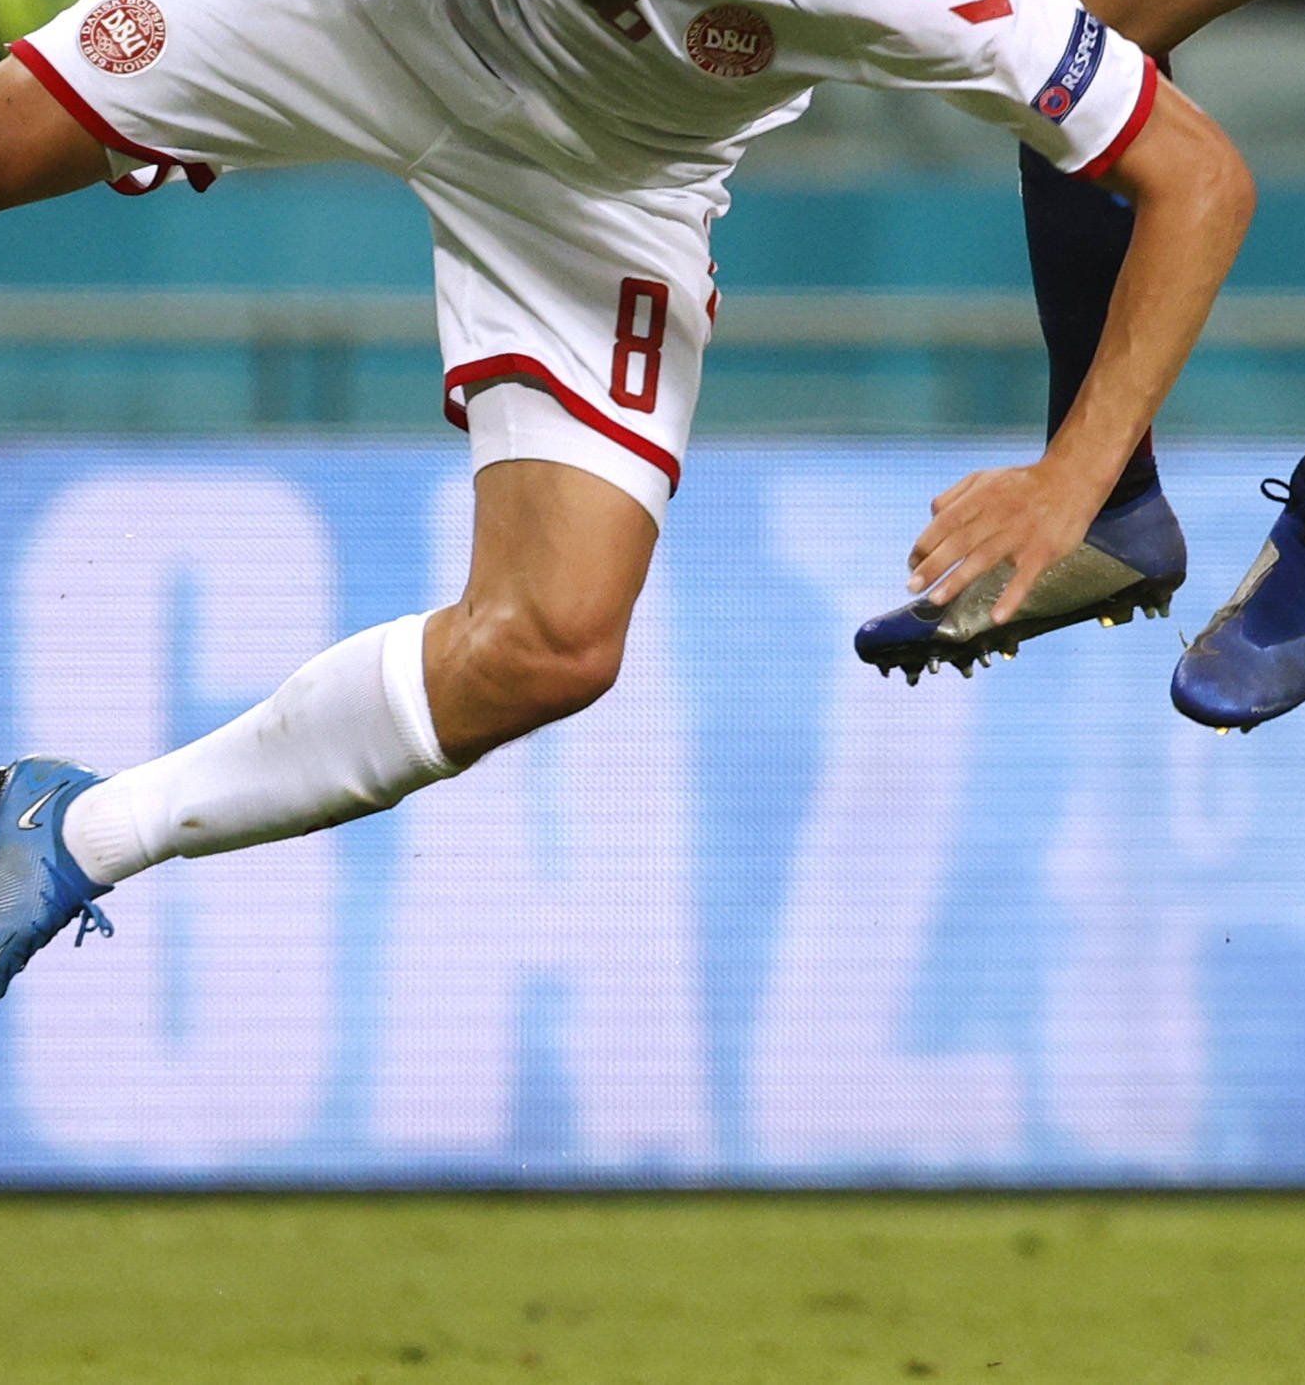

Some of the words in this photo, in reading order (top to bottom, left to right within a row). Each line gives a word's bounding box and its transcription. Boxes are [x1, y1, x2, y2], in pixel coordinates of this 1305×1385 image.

[99, 8, 149, 58] DBU
[703, 27, 759, 56] DBU
[112, 48, 159, 74] UNION
[609, 276, 669, 415] 8
